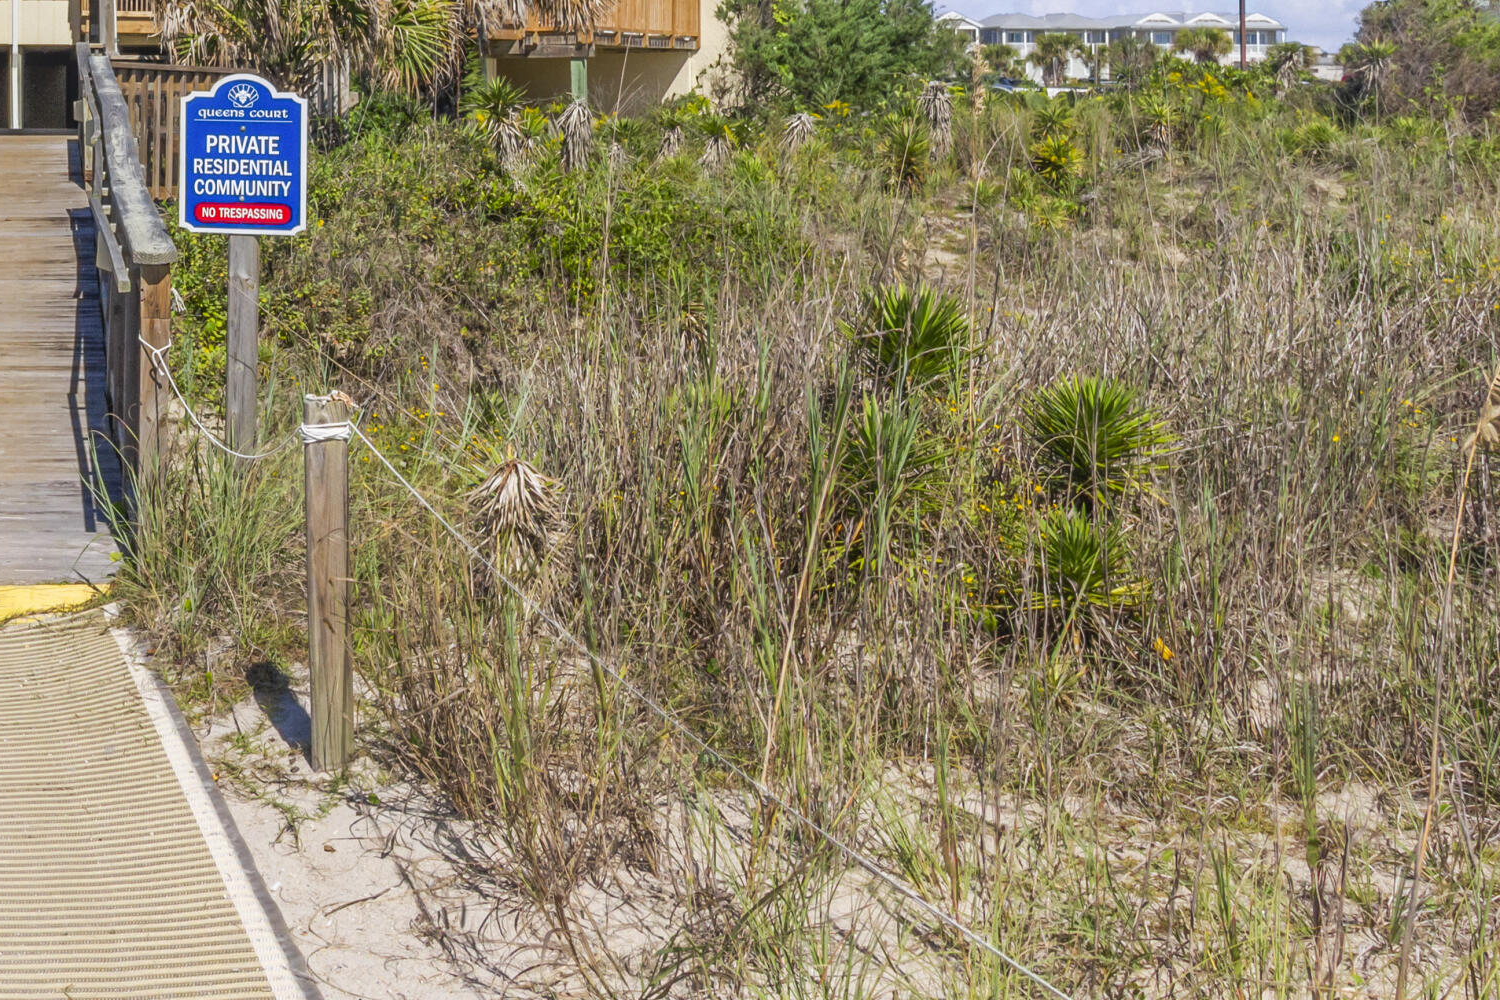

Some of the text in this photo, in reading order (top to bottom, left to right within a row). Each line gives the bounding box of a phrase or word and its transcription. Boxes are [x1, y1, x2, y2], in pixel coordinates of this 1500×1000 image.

[206, 135, 279, 155] PRIVATE
[193, 159, 292, 176] RESIDENTIAL
[194, 179, 291, 197] COMMUNITY
[201, 207, 283, 220] NO TRESPASSING
